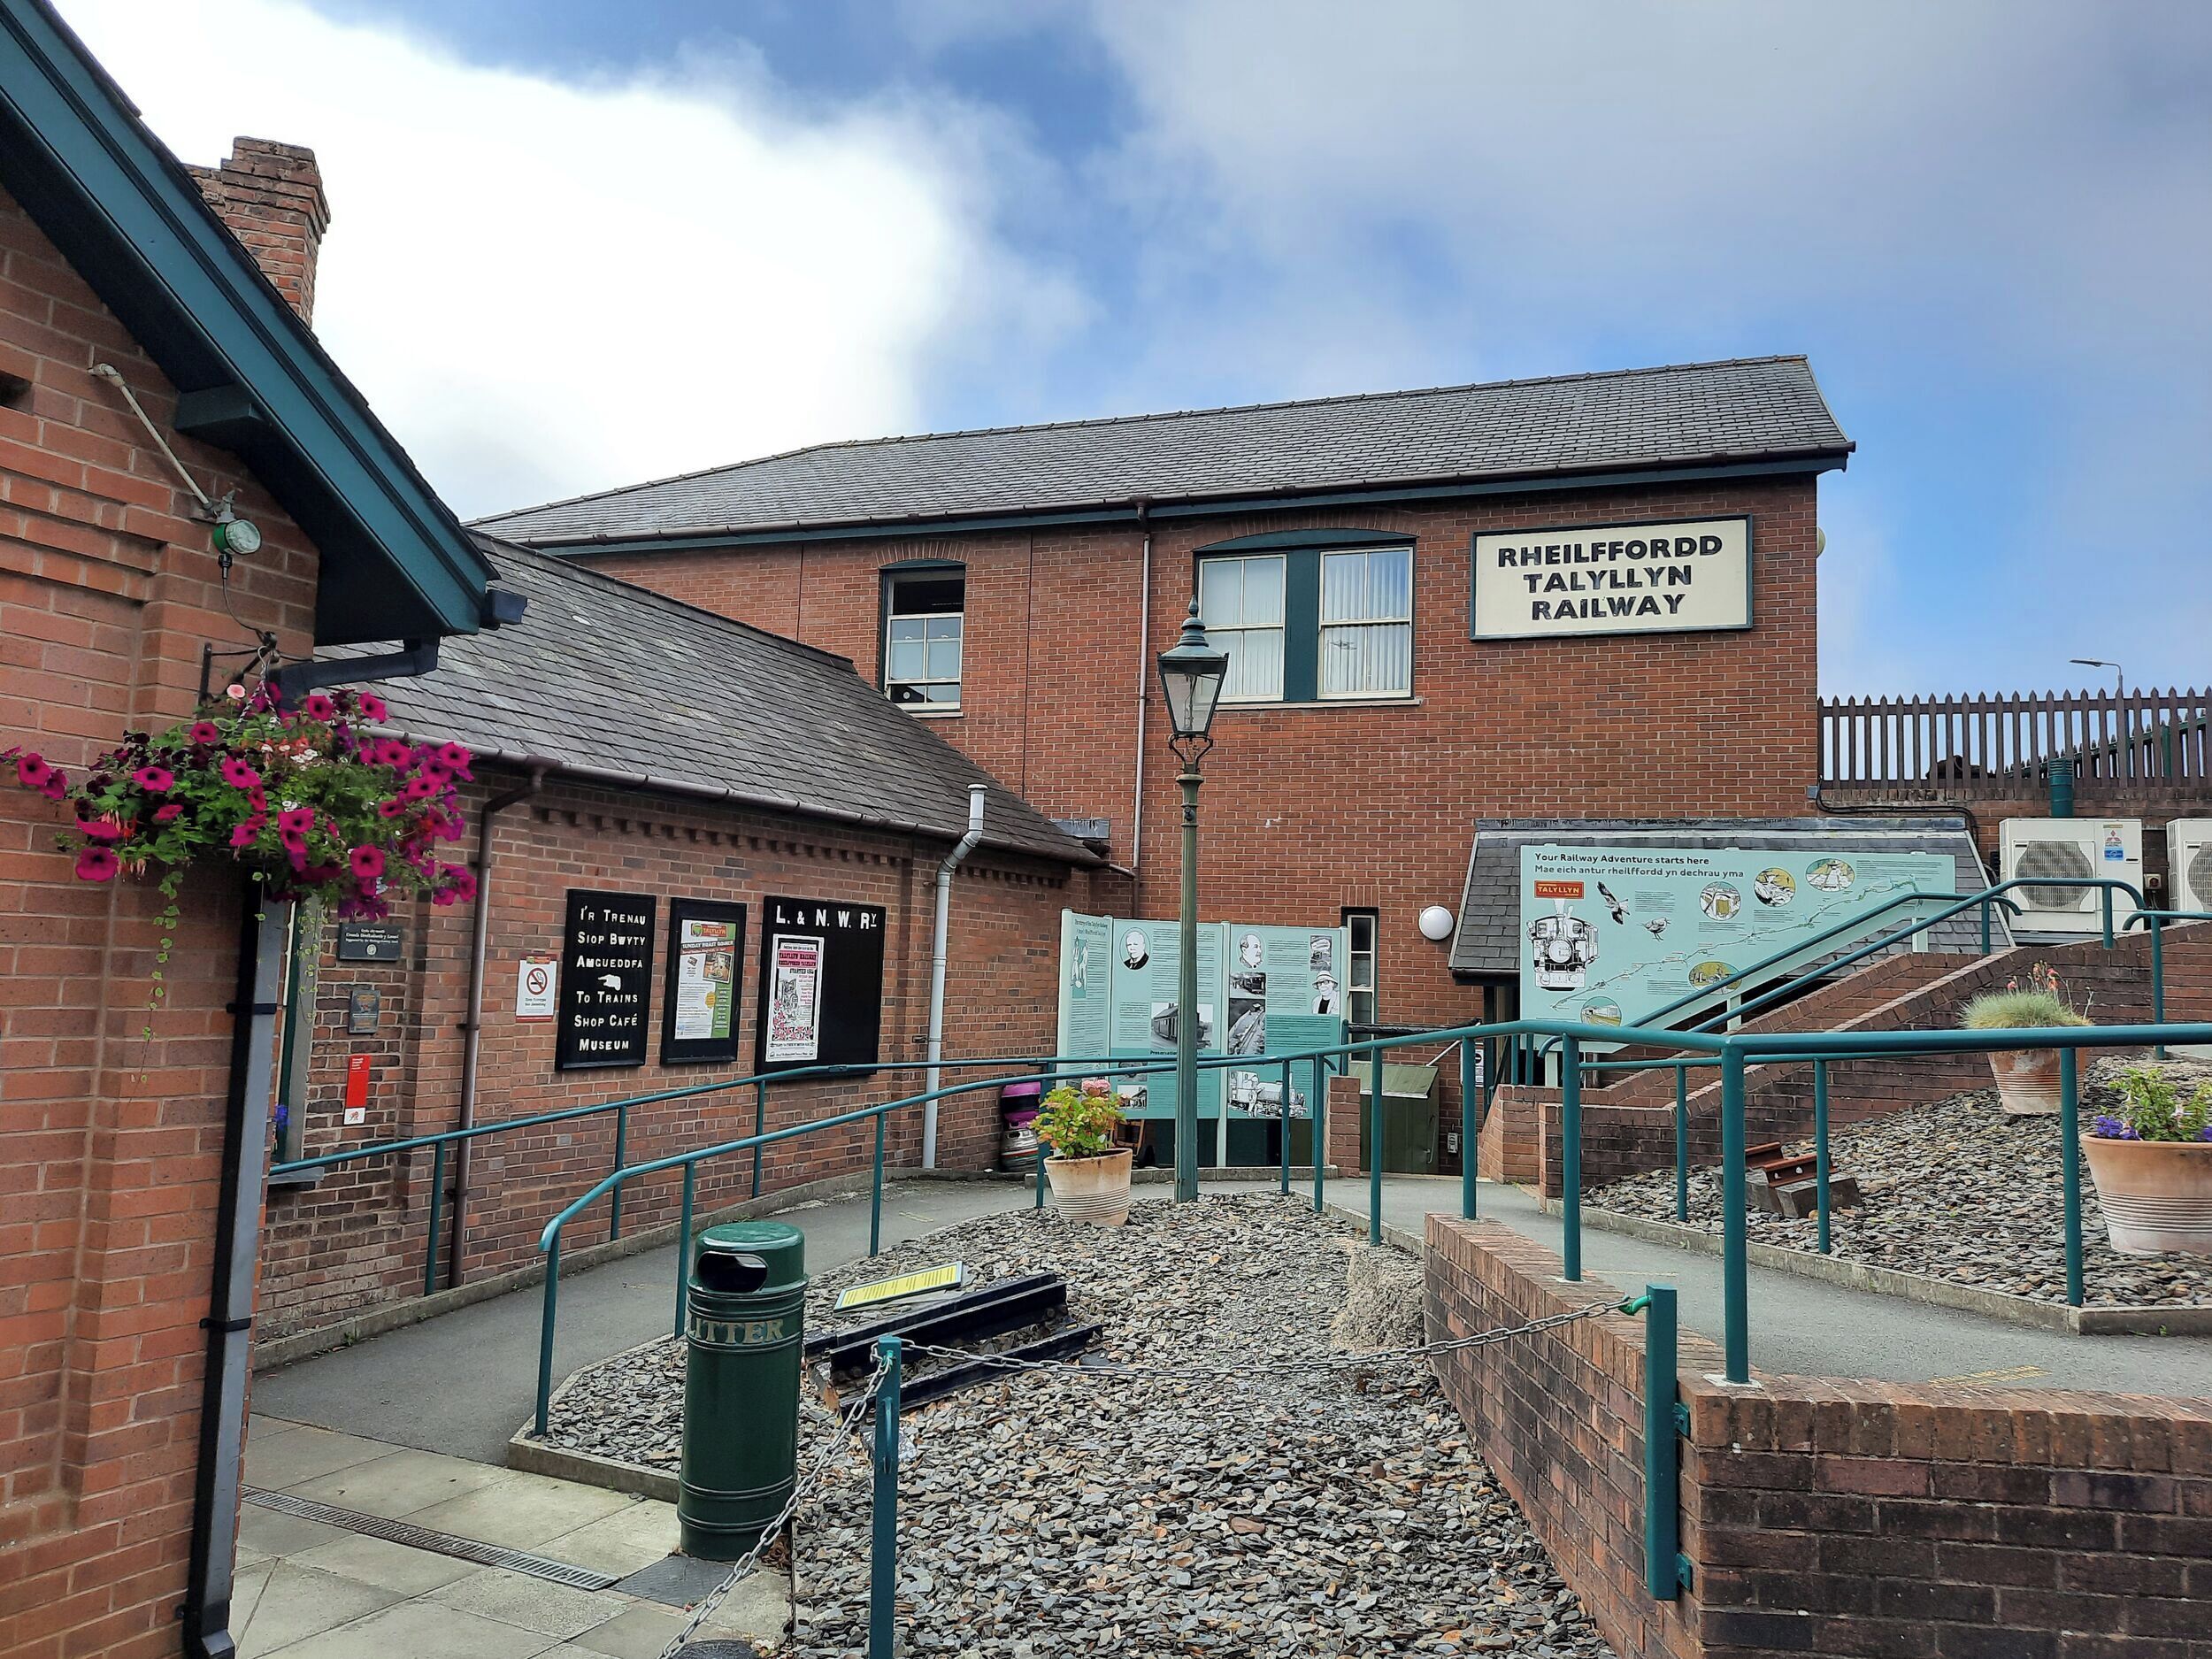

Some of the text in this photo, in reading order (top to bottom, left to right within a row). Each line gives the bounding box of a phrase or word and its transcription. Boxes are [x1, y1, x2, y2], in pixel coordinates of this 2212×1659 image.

[1498, 535, 1723, 568] RHEILFFORDD
[1523, 565, 1692, 594] TALYLLYN
[1532, 594, 1685, 620] RAILWAY
[1534, 853, 1558, 862] Your
[1560, 853, 1599, 864] Railway
[1601, 855, 1654, 864] Adventure
[1534, 864, 1555, 873] Mae
[1608, 866, 1663, 876] rheilffordd
[1679, 868, 1720, 877] dechrau
[603, 909, 647, 926] TRENAU
[775, 904, 791, 925] L.
[796, 910, 805, 926] &
[815, 909, 830, 927] N.
[837, 910, 851, 928] W.
[577, 931, 605, 945] SIOP
[576, 955, 643, 969] AMGUEDDFA
[576, 989, 638, 1004] TO TRAINS
[573, 1014, 605, 1027] SHOP
[579, 1038, 630, 1051] MUSEUM
